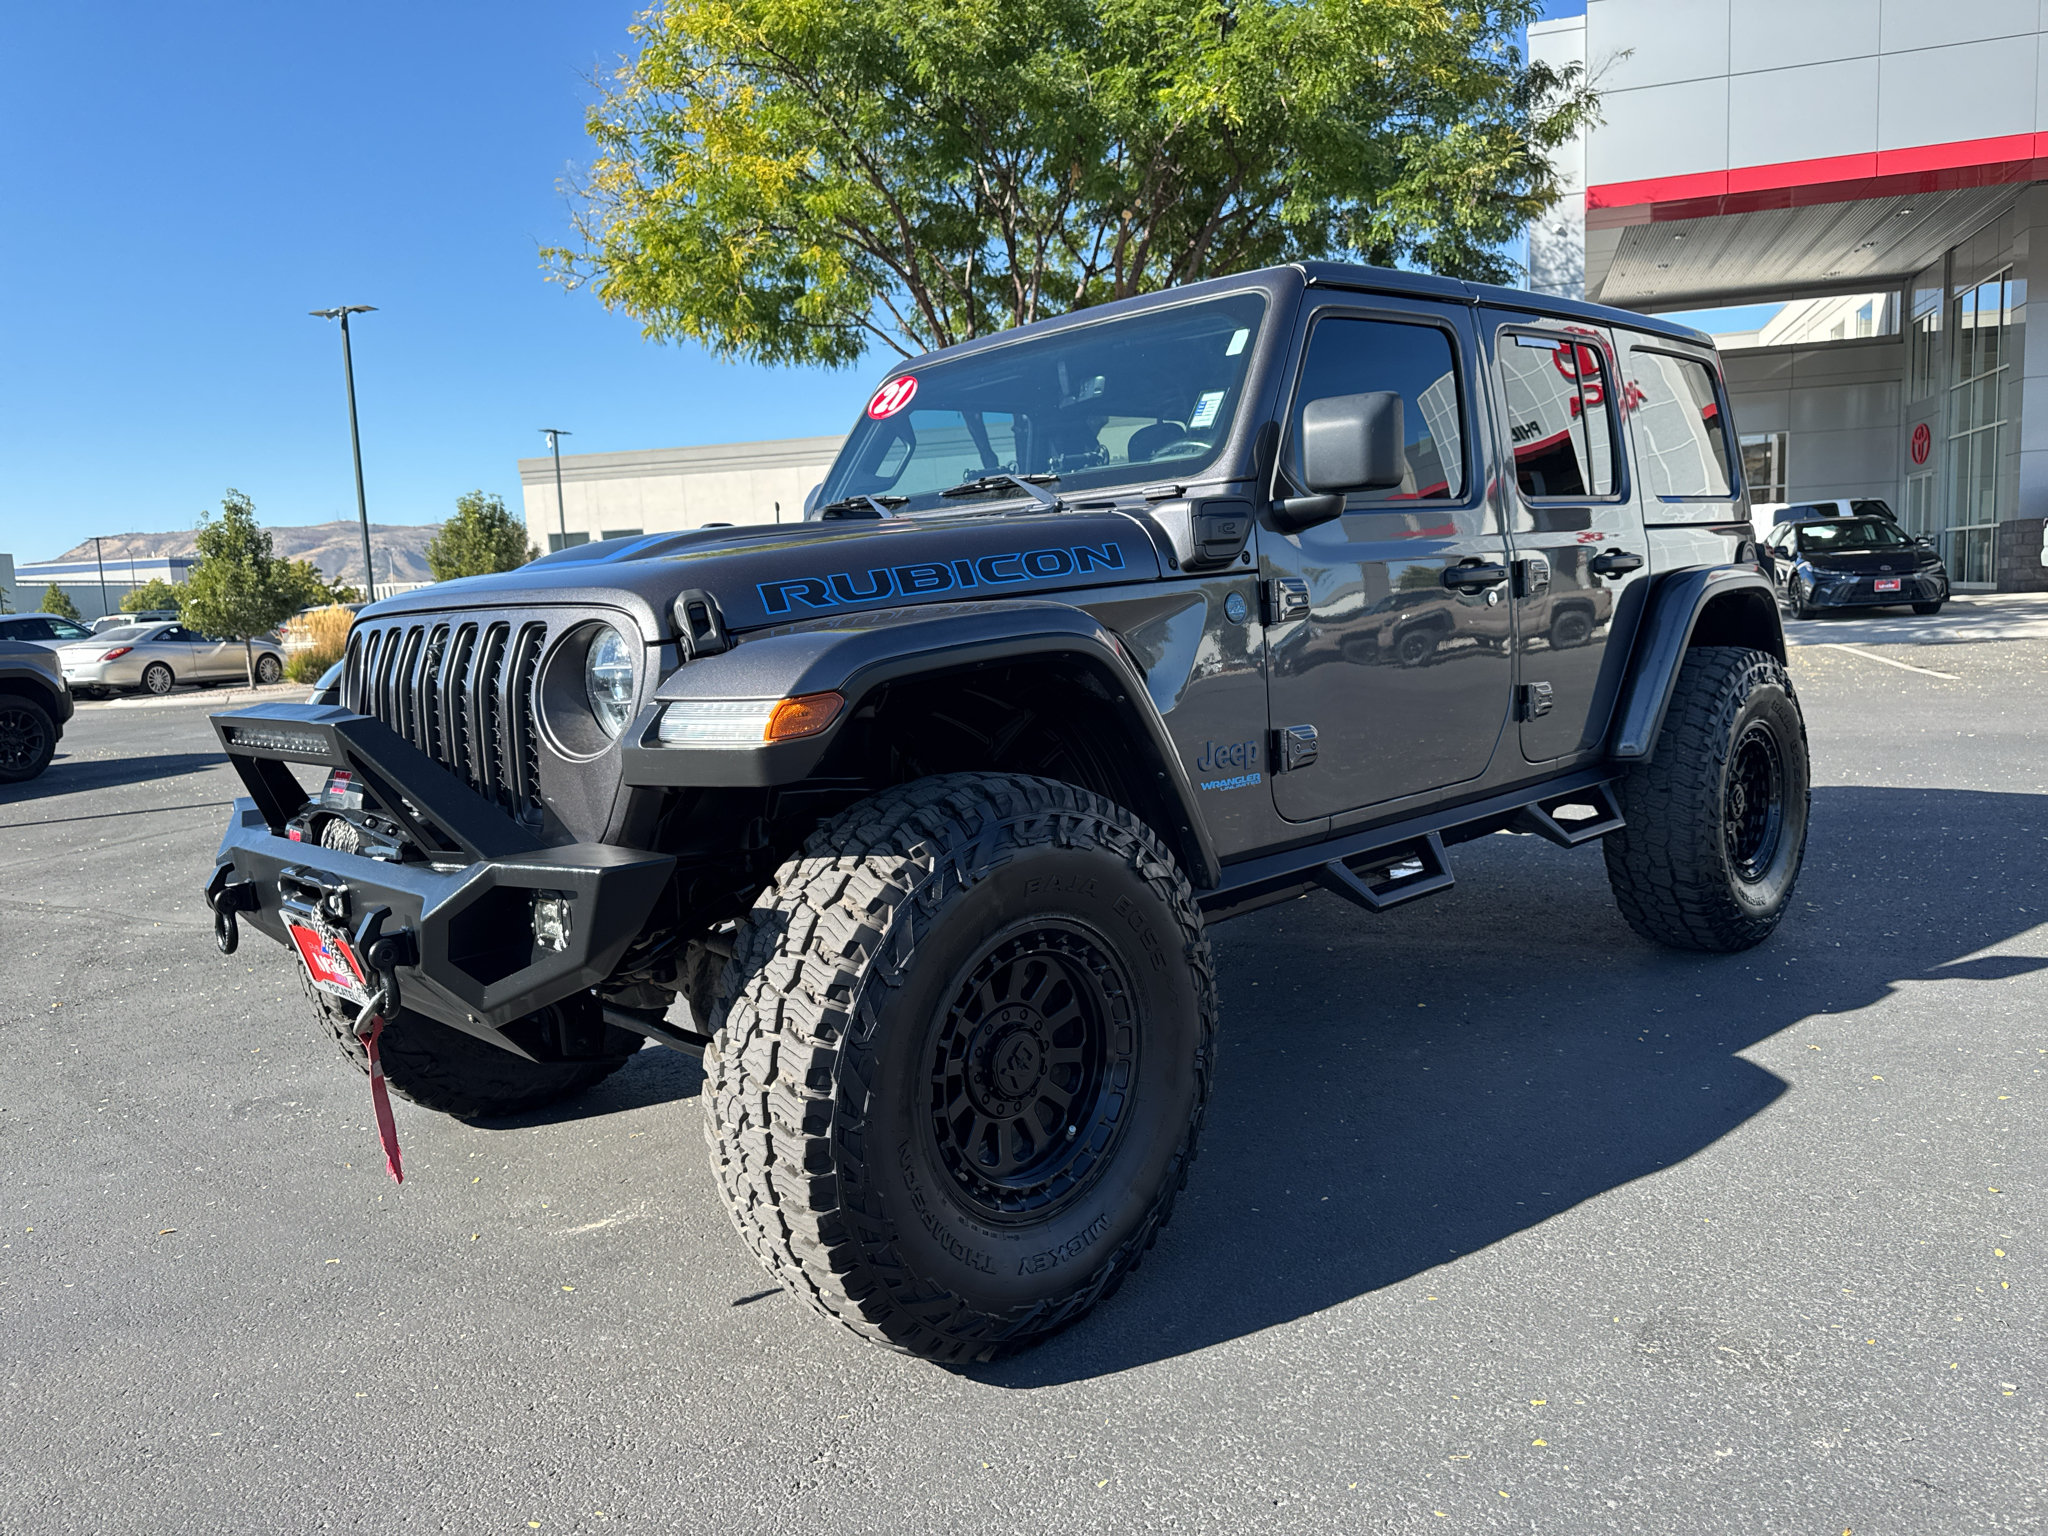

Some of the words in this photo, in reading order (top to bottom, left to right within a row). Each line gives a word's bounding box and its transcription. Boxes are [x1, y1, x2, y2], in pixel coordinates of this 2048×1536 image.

[873, 379, 914, 415] 21
[756, 542, 1126, 615] RUBICON
[1197, 740, 1257, 772] Jeep
[1200, 772, 1261, 791] WRANGLER
[1024, 872, 1098, 898] BAJA
[896, 1137, 997, 1276] THOMPSON
[1017, 1213, 1113, 1276] MICKEY
